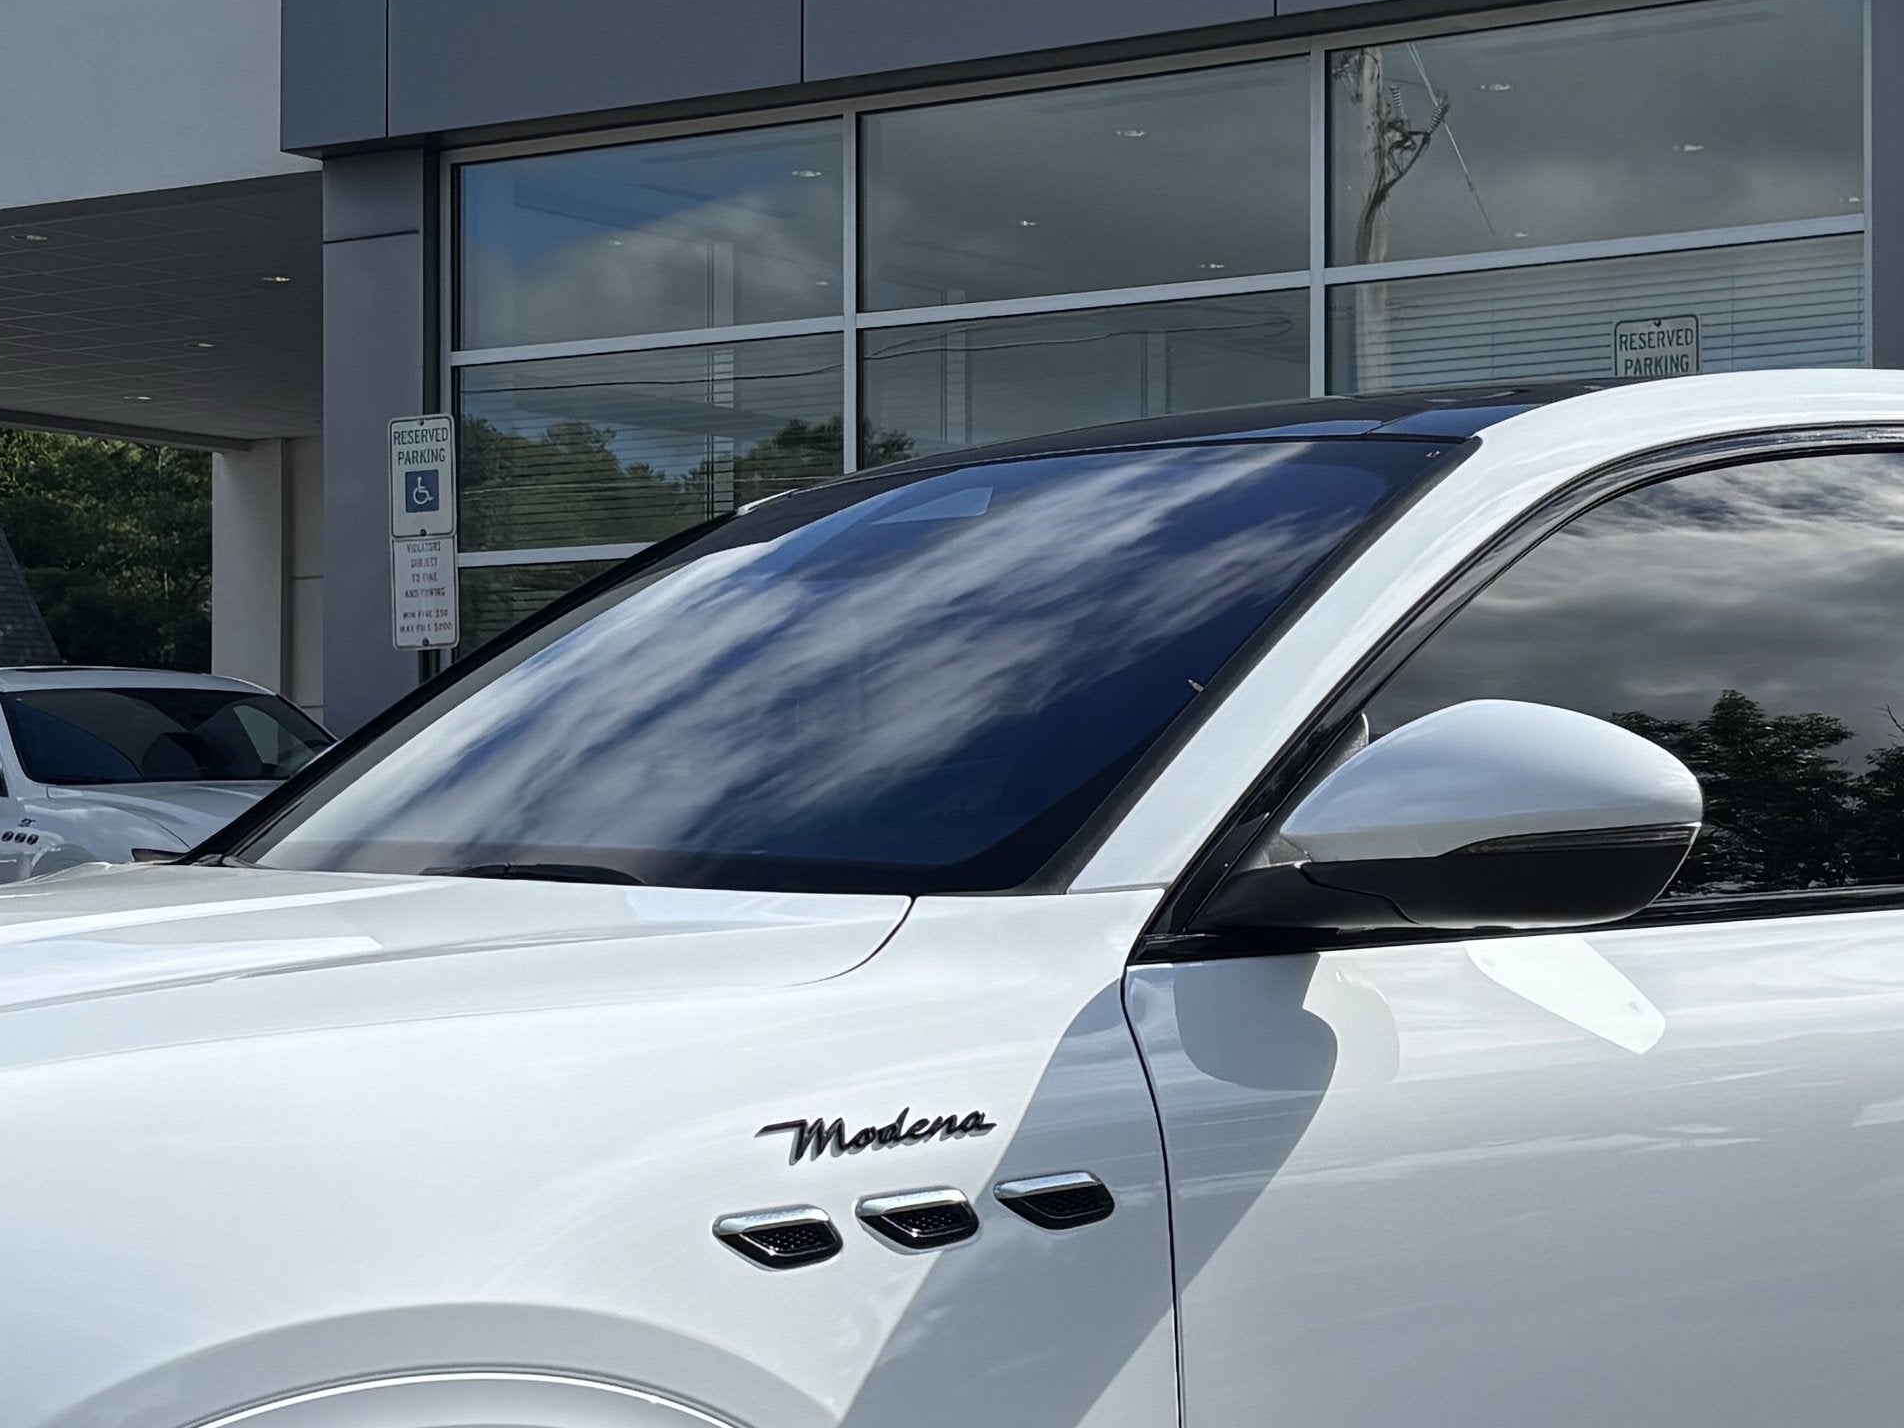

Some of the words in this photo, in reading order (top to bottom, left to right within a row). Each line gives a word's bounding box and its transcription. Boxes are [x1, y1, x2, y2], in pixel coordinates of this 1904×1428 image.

[1619, 328, 1694, 351] RESERVED
[1624, 354, 1690, 377] PARKING
[393, 427, 449, 445] RESERVED
[397, 448, 446, 465] PARKING
[754, 1106, 997, 1167] Modena
